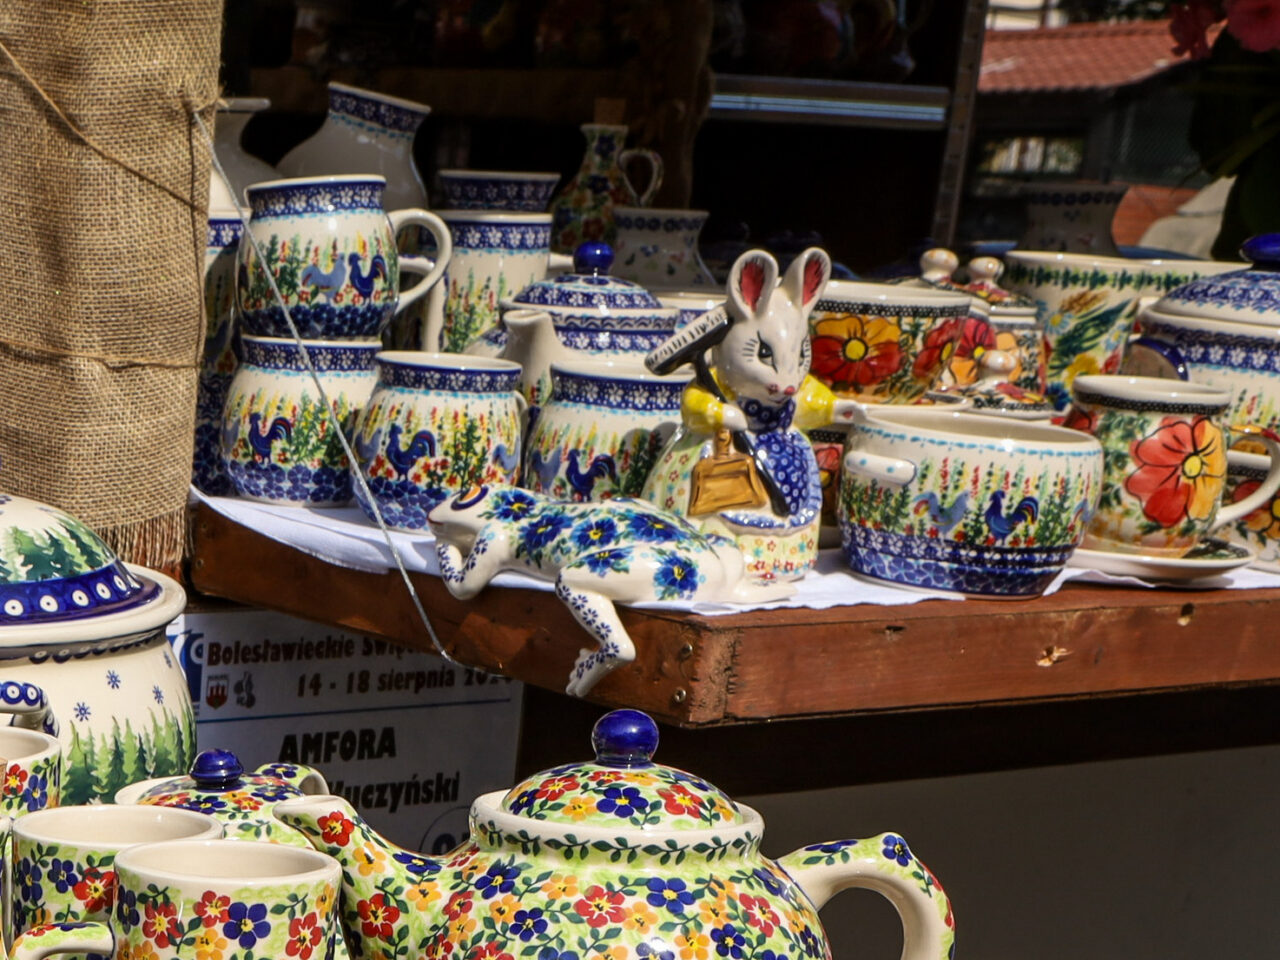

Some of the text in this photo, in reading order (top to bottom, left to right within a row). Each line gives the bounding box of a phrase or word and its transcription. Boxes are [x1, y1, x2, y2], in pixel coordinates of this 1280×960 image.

[207, 634, 354, 667] Bolesławieckie
[297, 672, 322, 698] 14
[346, 670, 370, 694] 18
[377, 665, 456, 695] sierpnia
[278, 727, 397, 764] AMFORA
